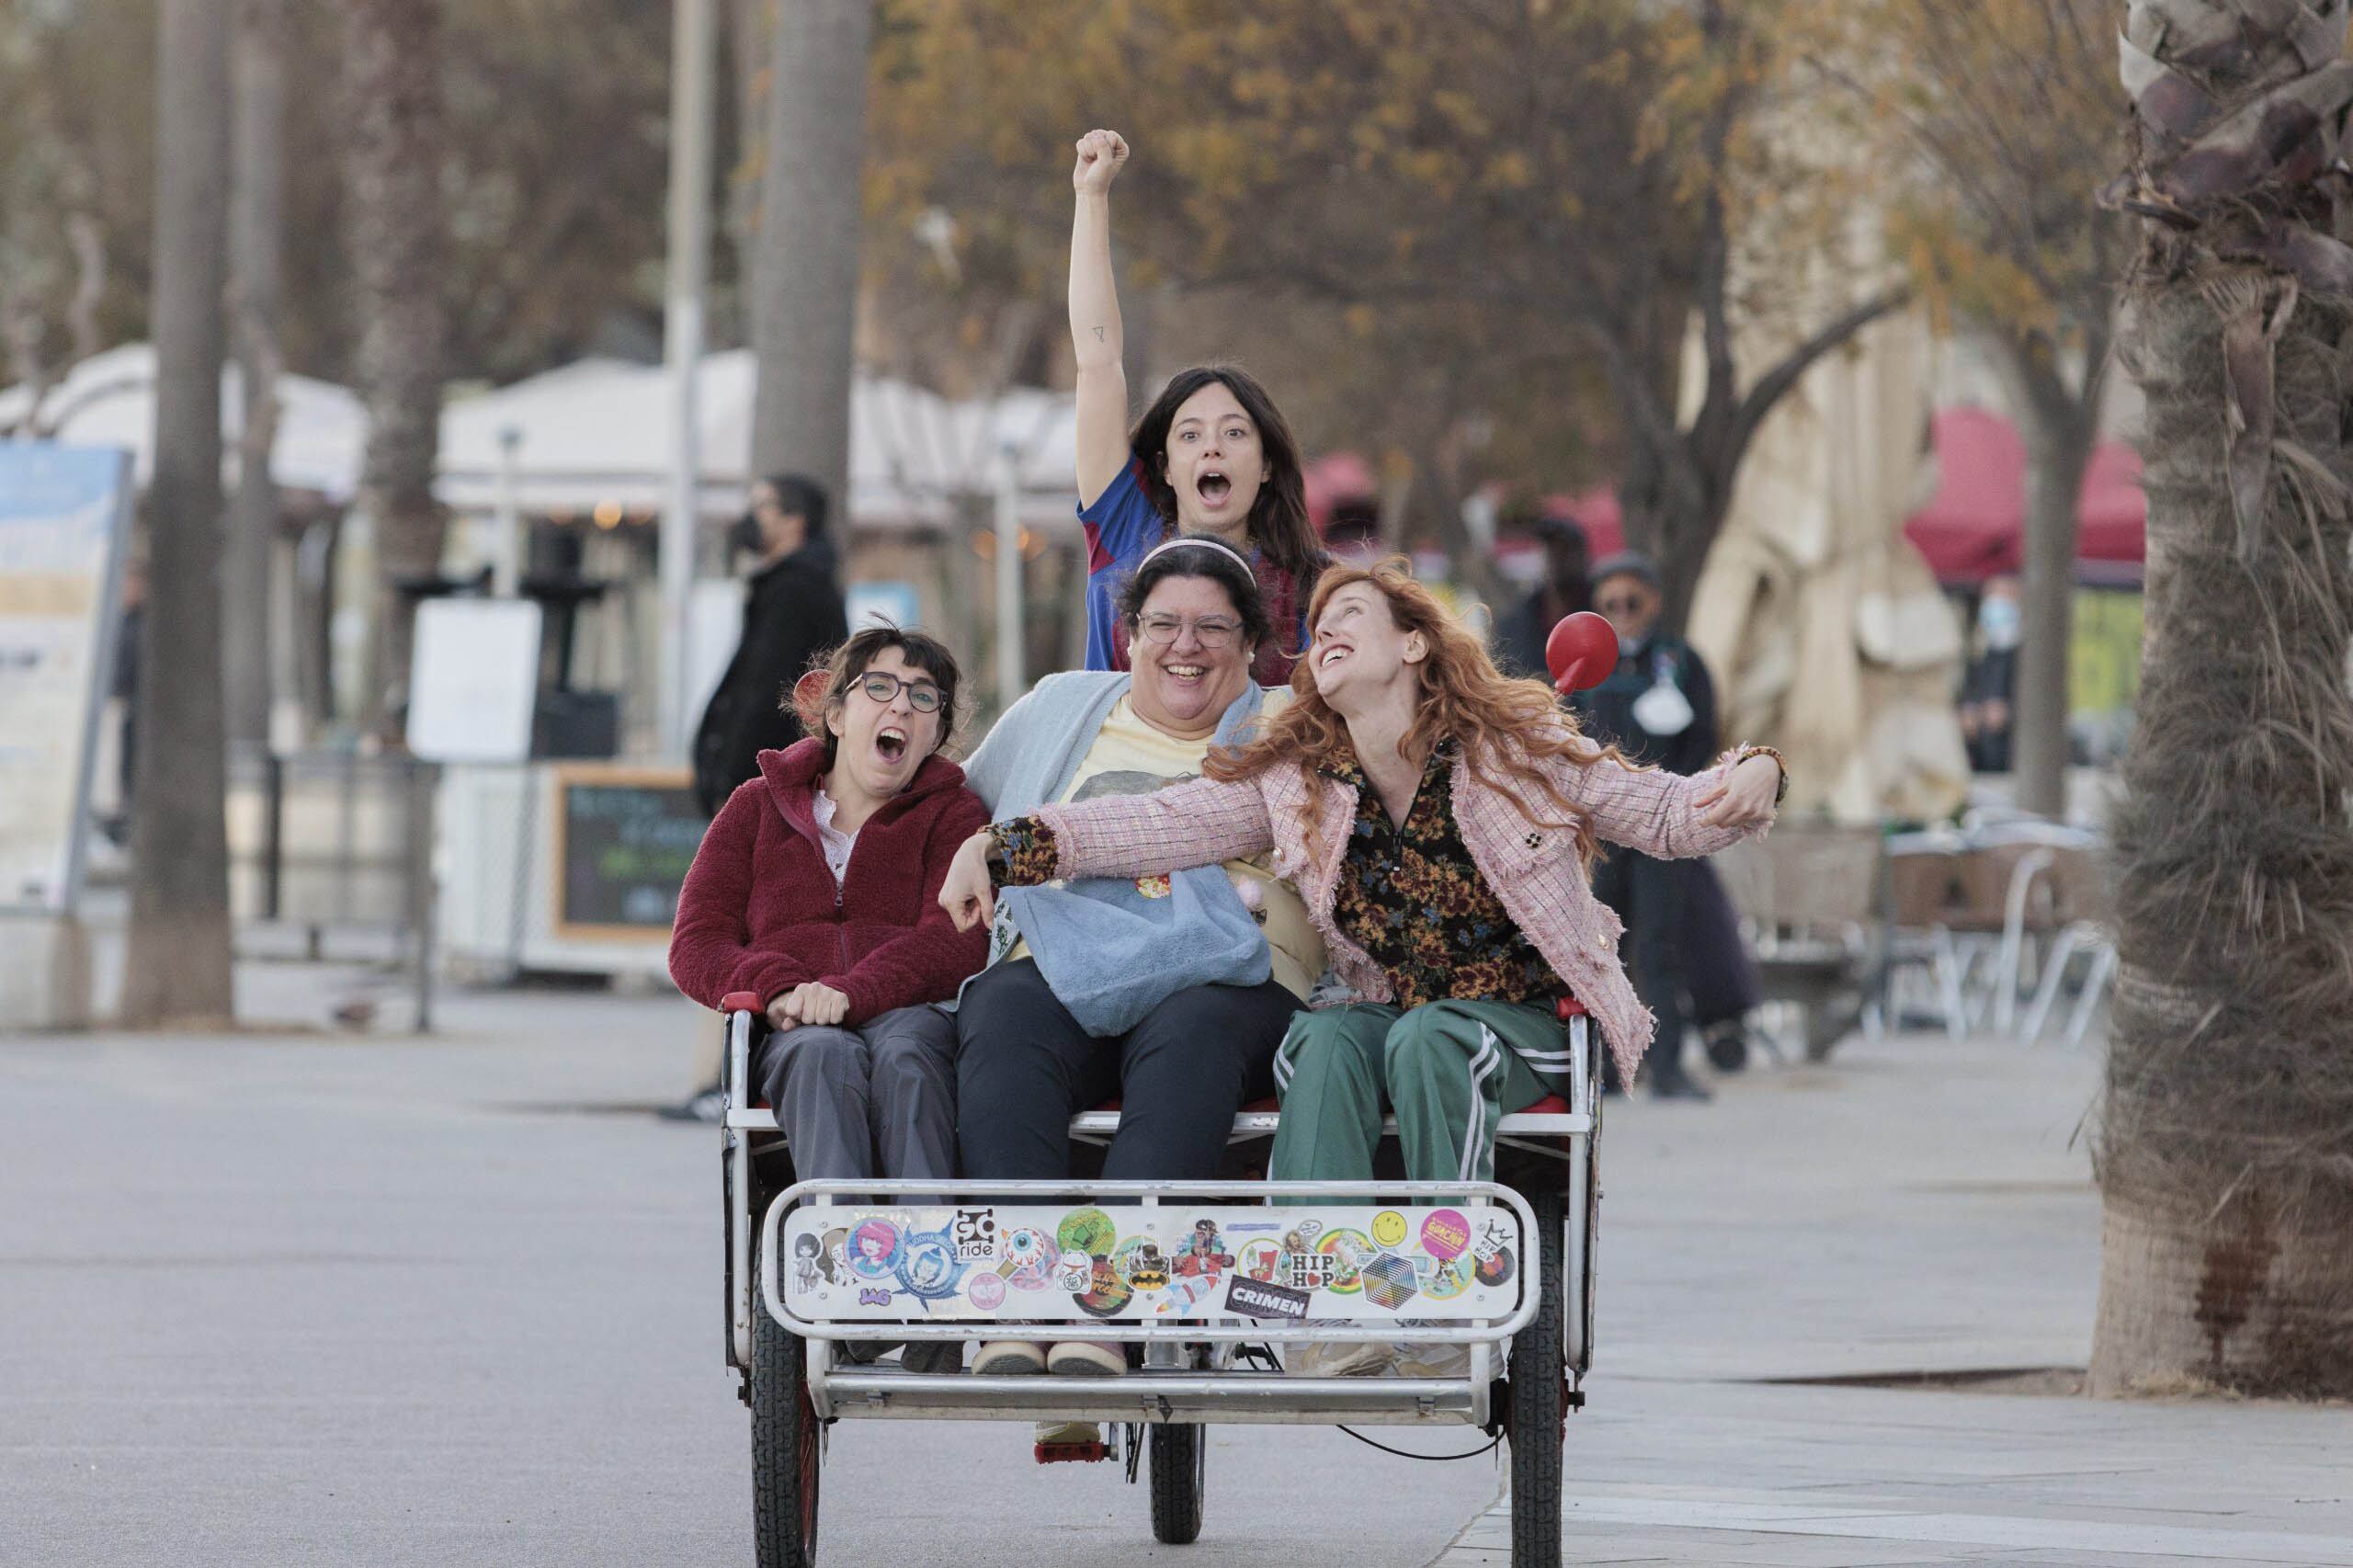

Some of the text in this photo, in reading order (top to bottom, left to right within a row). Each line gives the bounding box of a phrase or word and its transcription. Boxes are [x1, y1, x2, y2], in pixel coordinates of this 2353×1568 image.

[961, 1243, 993, 1256] ride
[1292, 1256, 1335, 1270] HIP
[1232, 1287, 1305, 1316] CRIMEN
